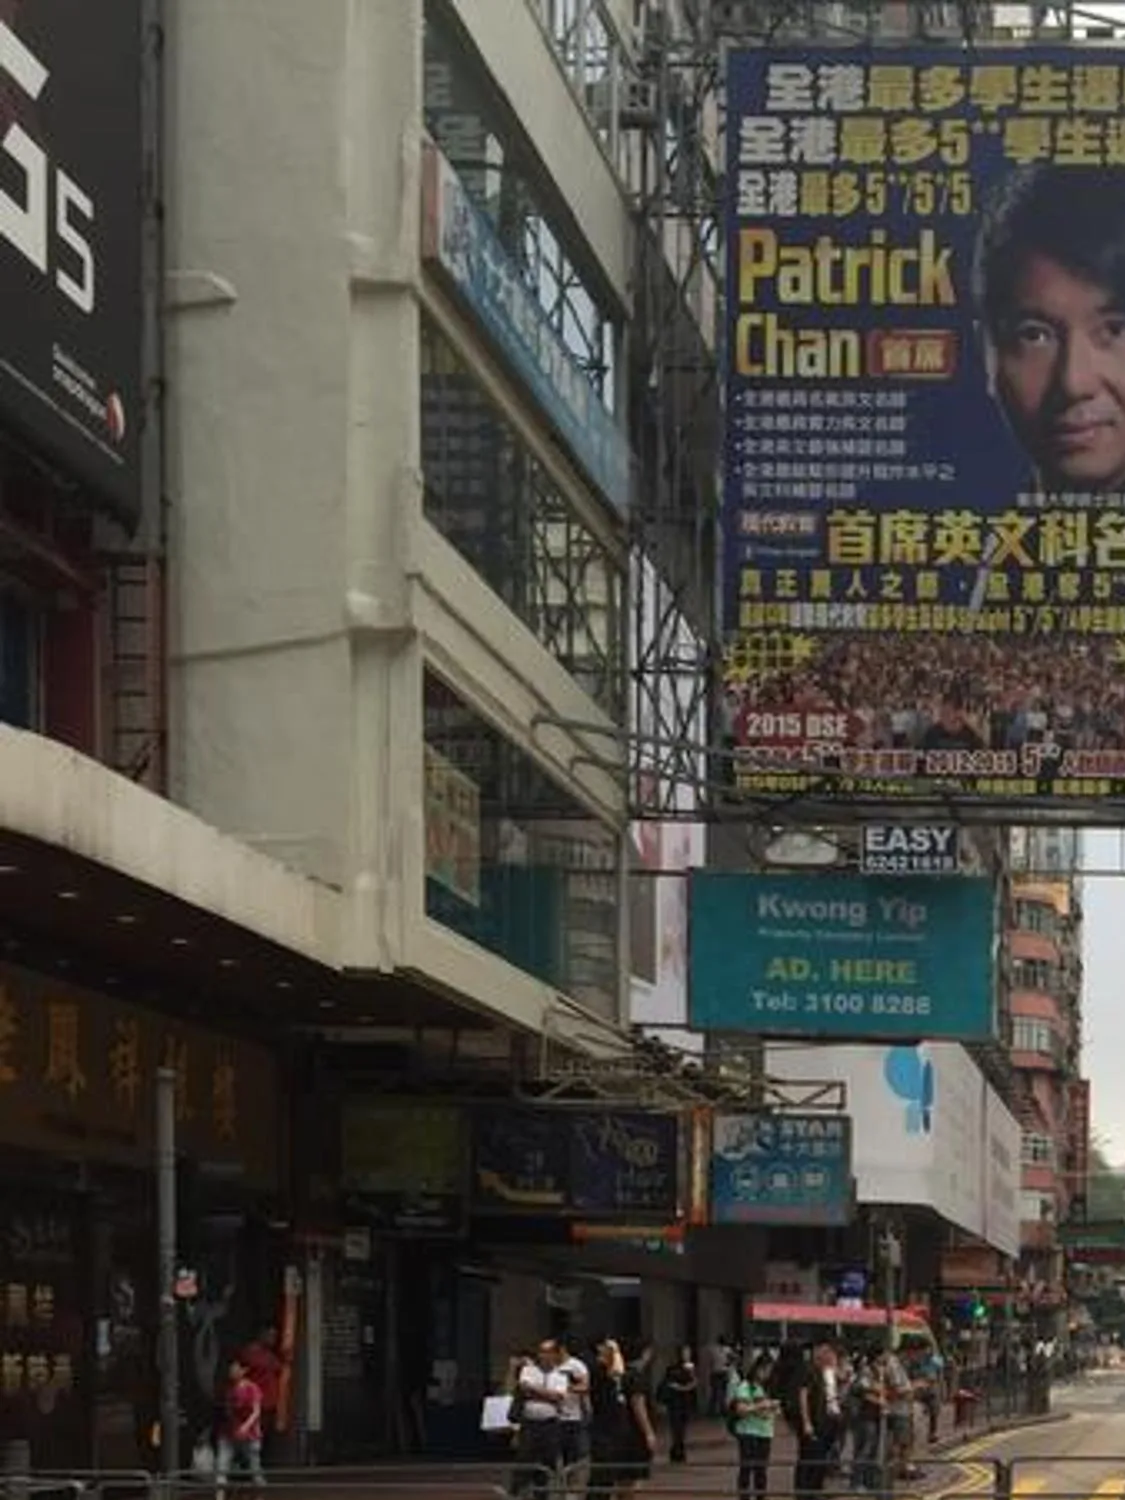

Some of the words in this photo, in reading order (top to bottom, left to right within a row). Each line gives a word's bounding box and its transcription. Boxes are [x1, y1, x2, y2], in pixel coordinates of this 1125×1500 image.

[738, 229, 956, 305] Patrick
[735, 312, 861, 377] Chan
[746, 711, 802, 739] 2015
[805, 711, 850, 739] DSE
[866, 826, 952, 852] EASY
[758, 892, 867, 928] Kwong
[877, 894, 929, 930] Yip
[765, 956, 821, 983] AD.
[829, 957, 918, 985] HERE
[803, 991, 865, 1015] 3100
